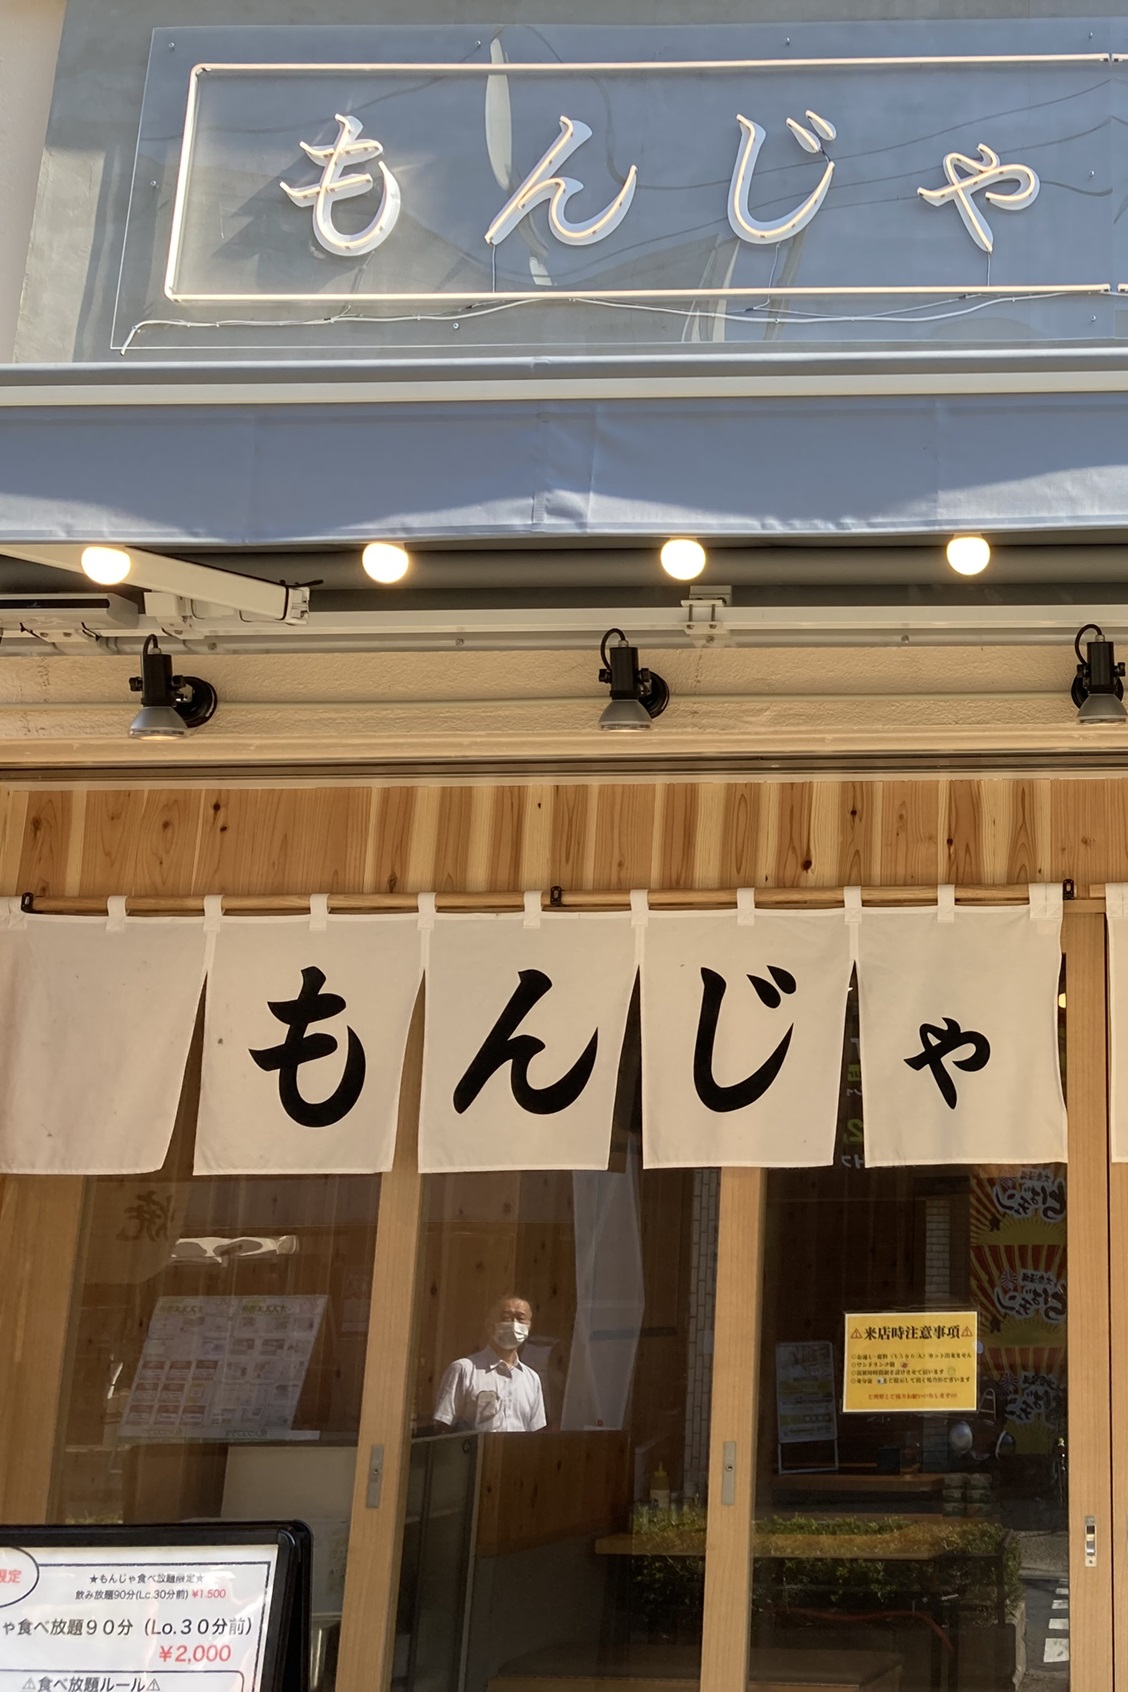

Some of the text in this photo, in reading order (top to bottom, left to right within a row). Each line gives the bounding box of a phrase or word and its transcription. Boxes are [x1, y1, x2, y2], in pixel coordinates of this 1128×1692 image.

[864, 1325, 960, 1341] 来店時注意事項
